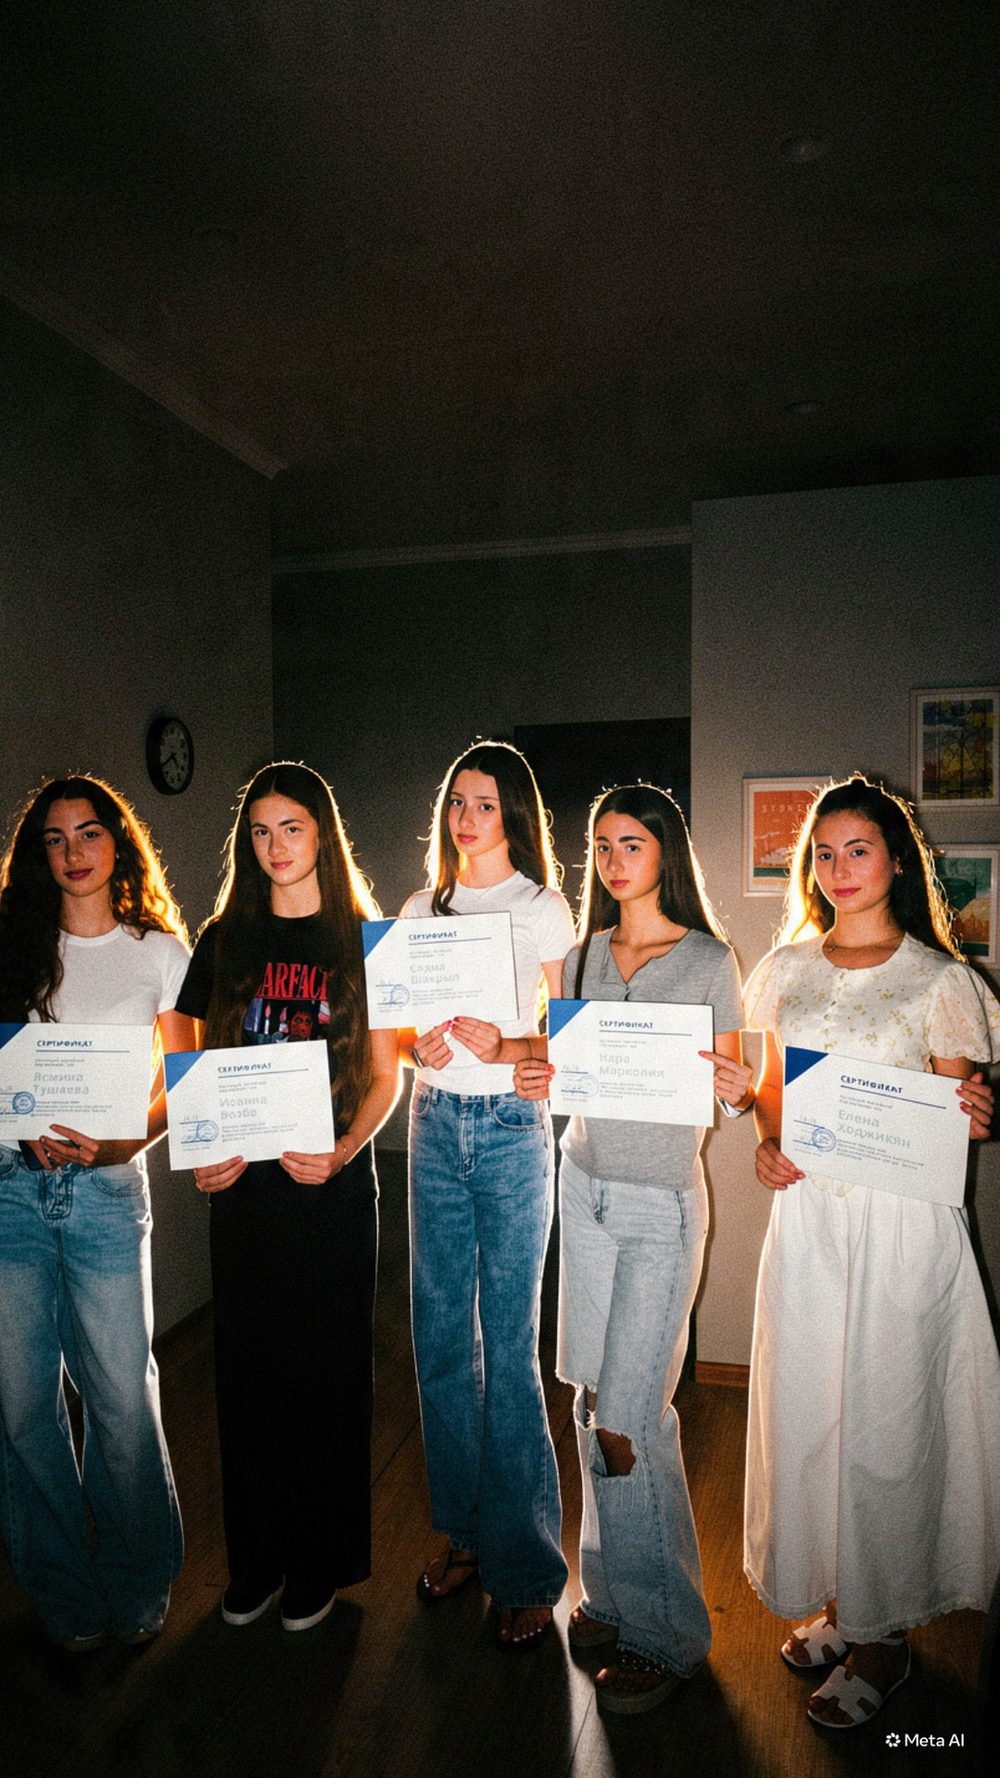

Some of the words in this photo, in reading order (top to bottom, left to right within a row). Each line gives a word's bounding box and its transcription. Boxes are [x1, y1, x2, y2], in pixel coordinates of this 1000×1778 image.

[408, 930, 458, 941] СЕРТИФИКАТ
[598, 1020, 653, 1029] СЕРТИФИКАТ
[37, 1040, 93, 1048] СЕРТИФИКАТ
[217, 1062, 272, 1073] СЕРТИФИКАТ
[840, 1075, 903, 1094] СЕРТИФИКАТ
[838, 1109, 880, 1128] Елена
